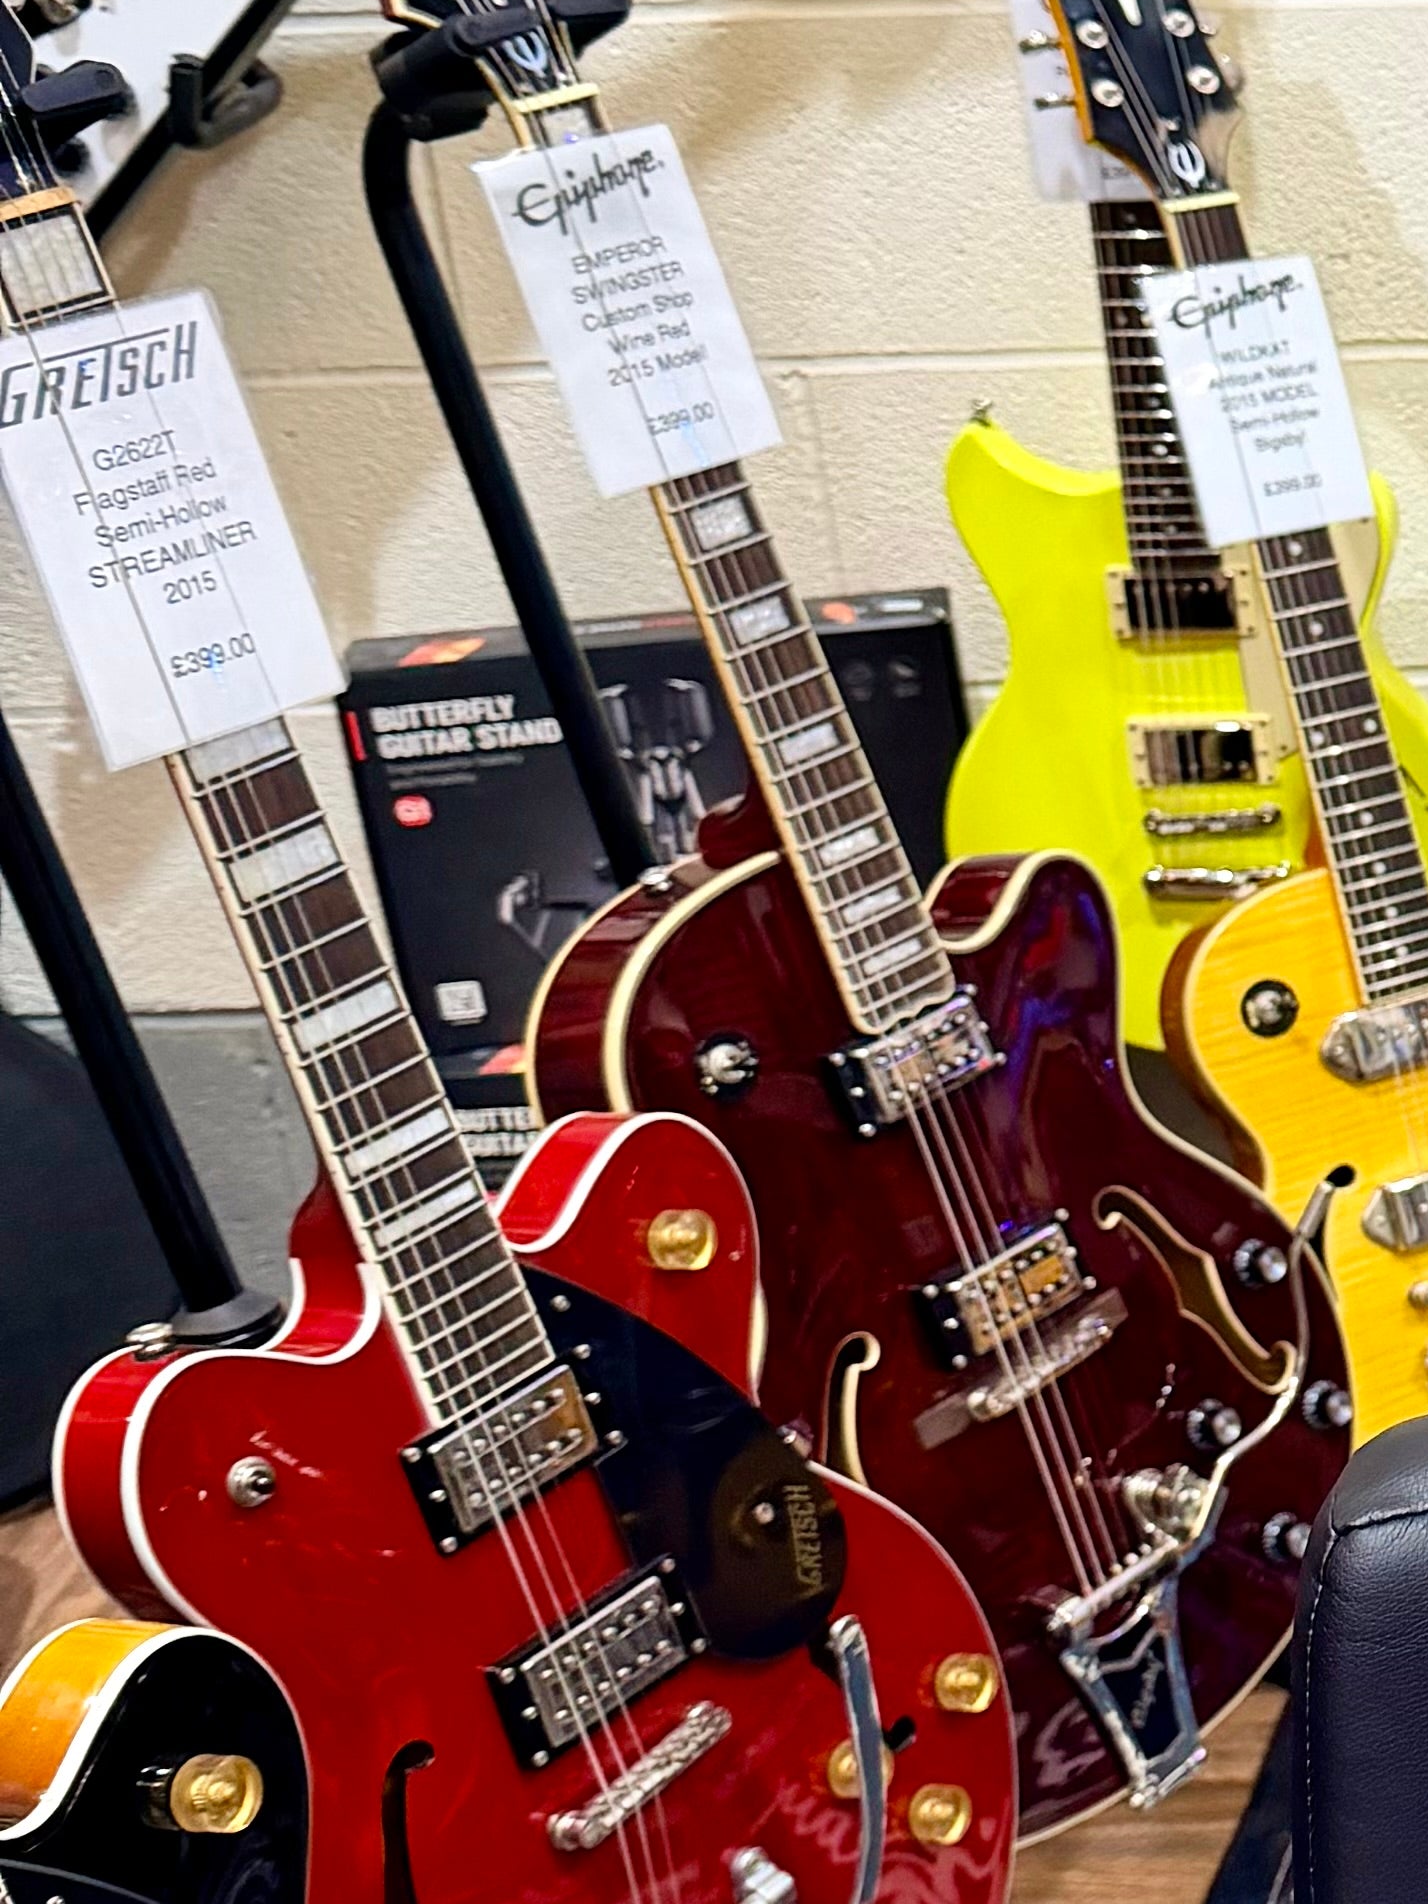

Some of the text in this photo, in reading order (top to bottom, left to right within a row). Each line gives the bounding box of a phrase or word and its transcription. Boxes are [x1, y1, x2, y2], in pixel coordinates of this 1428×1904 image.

[571, 235, 668, 275] EMPEROR
[571, 261, 685, 305] SWINGSTER
[582, 289, 695, 332] Custom Shop
[607, 321, 691, 355] Wine Red
[0, 320, 198, 430] GRETSCH
[607, 360, 656, 387] 2015
[1260, 381, 1319, 403] MODEL
[92, 429, 178, 472] G2622T
[73, 457, 218, 516] Flagstaff Red
[94, 497, 228, 548] Semi-Hollow
[88, 520, 259, 590] STREAMLINER
[163, 570, 218, 605] 2015
[170, 632, 257, 680] £399.00
[369, 693, 515, 733] BUTTERFLY
[374, 716, 566, 759] GUITAR STAND
[782, 1484, 823, 1588] GRETSCH
